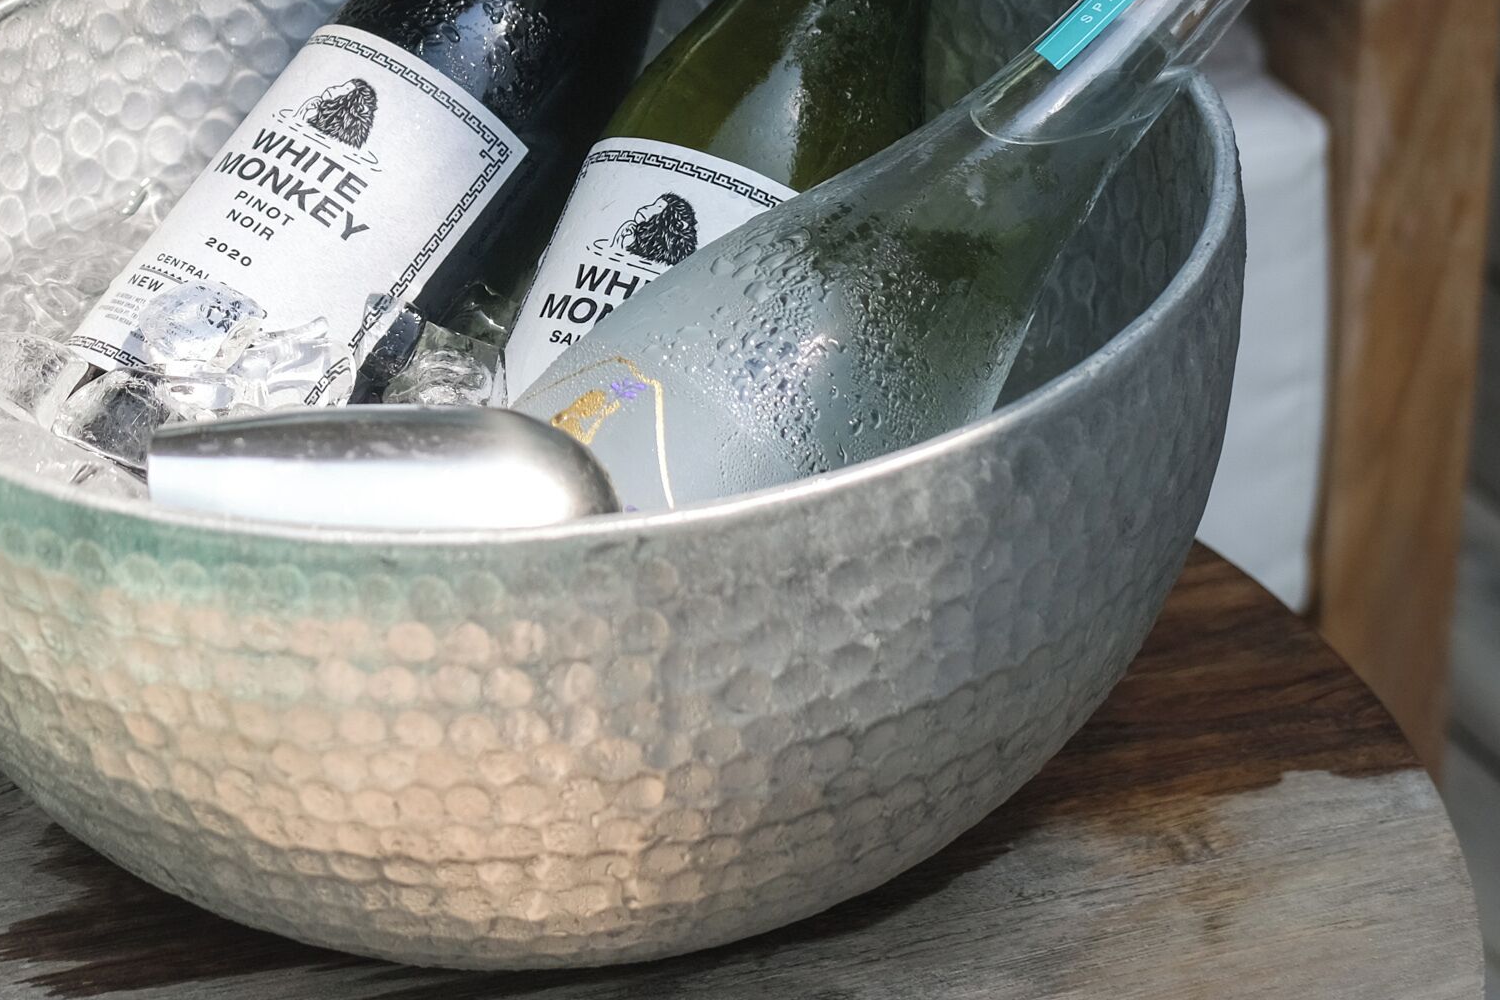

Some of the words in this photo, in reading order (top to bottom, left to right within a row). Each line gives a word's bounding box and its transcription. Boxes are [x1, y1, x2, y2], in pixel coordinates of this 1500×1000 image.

[252, 128, 368, 204] WHITE
[214, 151, 370, 241] MONKEY
[234, 190, 295, 227] PINOT
[226, 208, 275, 241] NOIR
[204, 236, 253, 267] 2020
[127, 273, 164, 292] NEW
[575, 263, 652, 300] WH
[549, 329, 582, 346] SA
